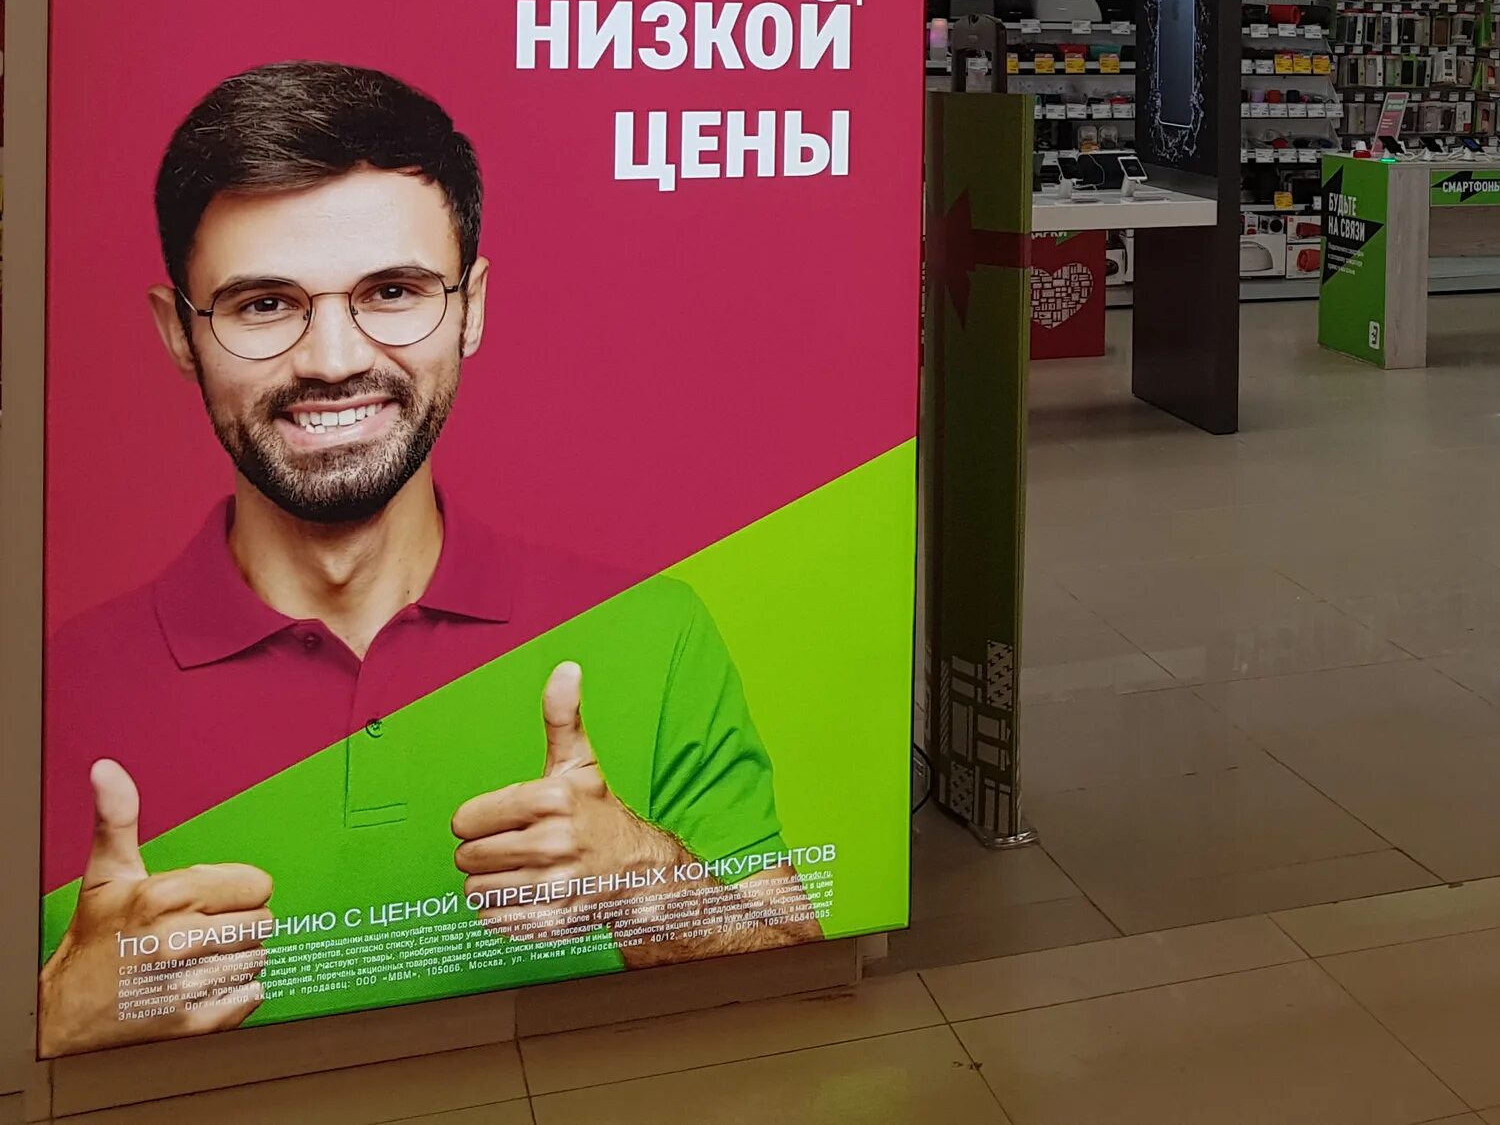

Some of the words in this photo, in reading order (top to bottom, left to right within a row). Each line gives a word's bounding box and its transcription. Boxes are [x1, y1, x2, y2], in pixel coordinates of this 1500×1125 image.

[613, 109, 850, 192] ЦЕНЫ
[1328, 192, 1357, 217] БУДЬТЕ
[1328, 217, 1339, 236] НА
[1340, 218, 1366, 242] СВЯЗИ
[119, 934, 159, 958] ПО
[167, 910, 335, 952] СРАВНЕНИЮ
[343, 906, 361, 928] С
[369, 891, 458, 928] ЦЕНОЙ
[465, 866, 666, 914] ОПРЕДЕЛЕННЫХ
[673, 843, 835, 882] КОНКУРЕНТОВ
